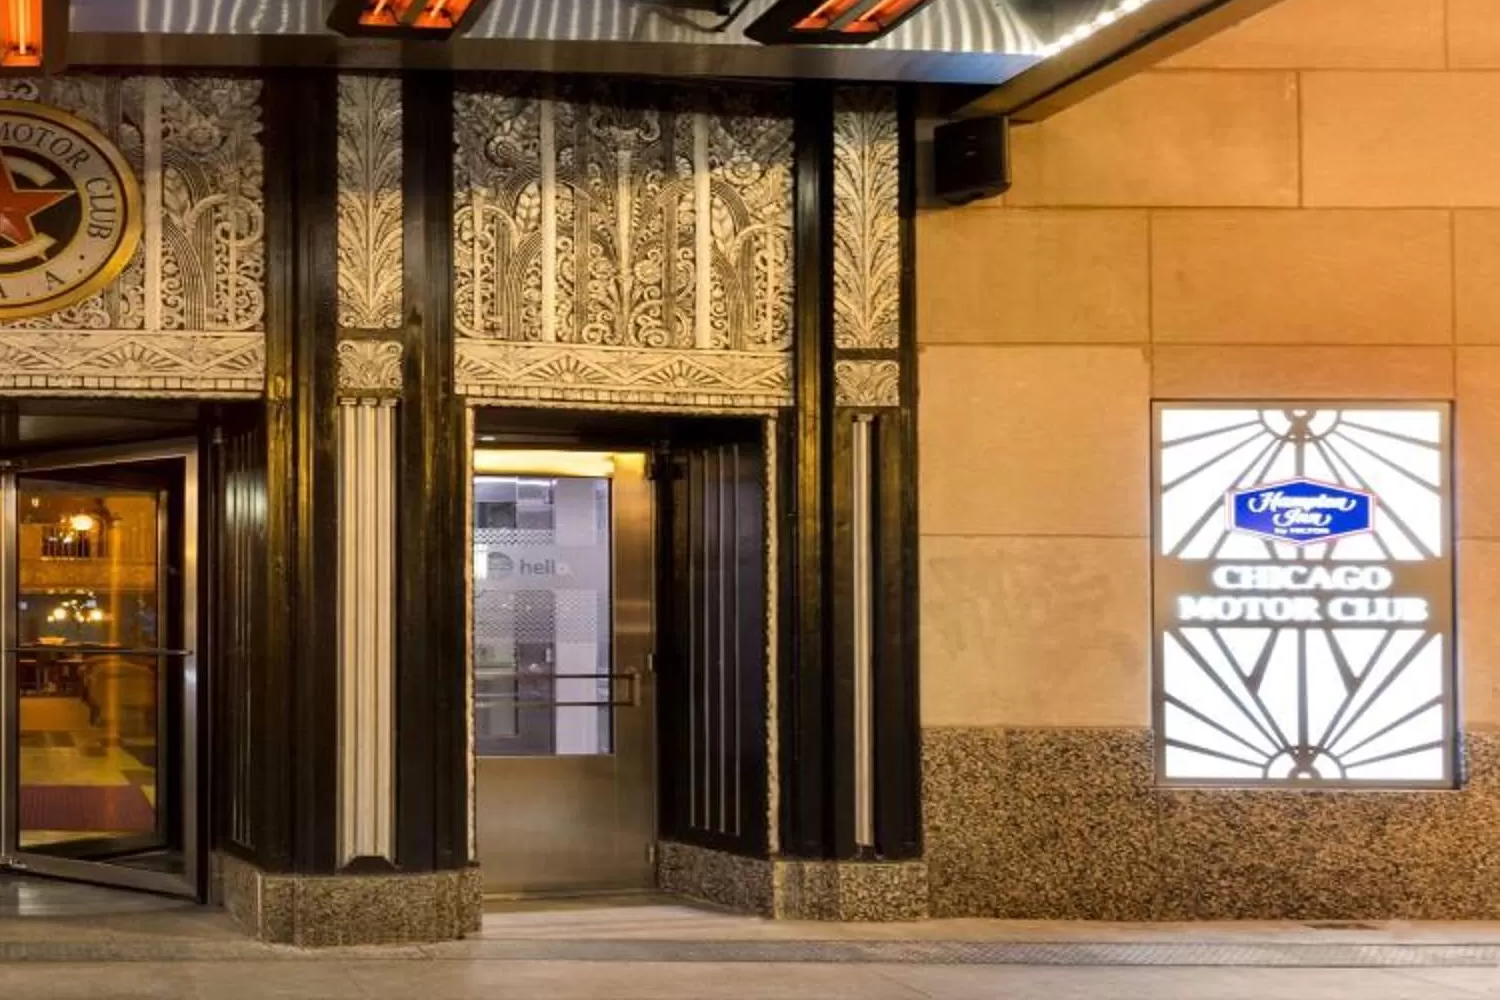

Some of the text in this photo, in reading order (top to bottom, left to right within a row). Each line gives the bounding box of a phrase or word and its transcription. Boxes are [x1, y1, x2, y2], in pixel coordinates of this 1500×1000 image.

[84, 176, 117, 239] CLUB
[1212, 565, 1393, 591] CHICAGO
[1176, 595, 1429, 622] MOTOR CLUB
